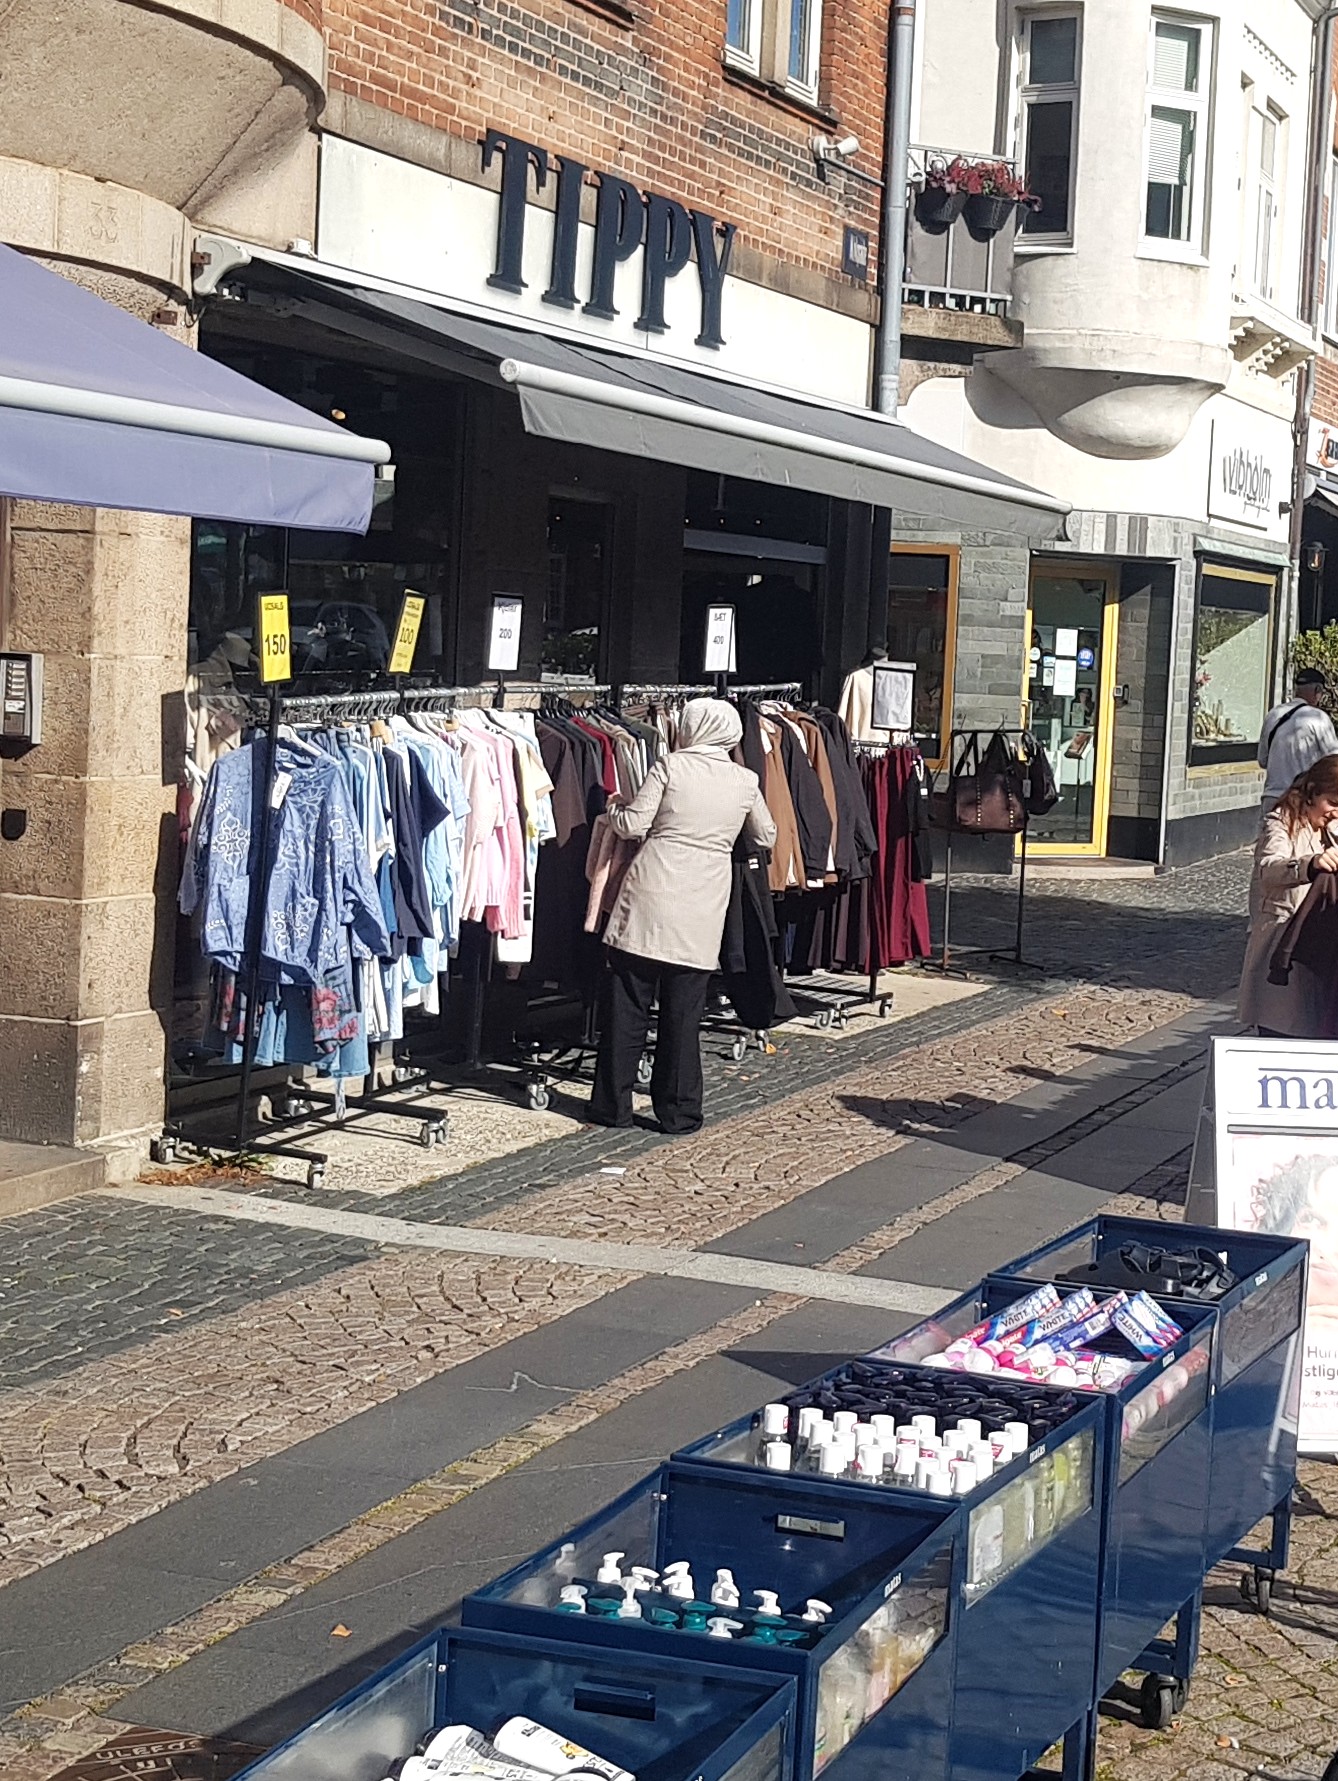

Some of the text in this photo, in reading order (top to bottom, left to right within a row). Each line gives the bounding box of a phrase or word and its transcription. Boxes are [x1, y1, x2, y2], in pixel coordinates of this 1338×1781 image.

[478, 127, 738, 350] TIPPY
[399, 627, 414, 645] 100
[499, 628, 513, 639] 200
[265, 634, 287, 656] 150
[1001, 1310, 1028, 1328] WHITE
[1039, 1314, 1068, 1332] WHITE
[1117, 1312, 1143, 1343] WHITE
